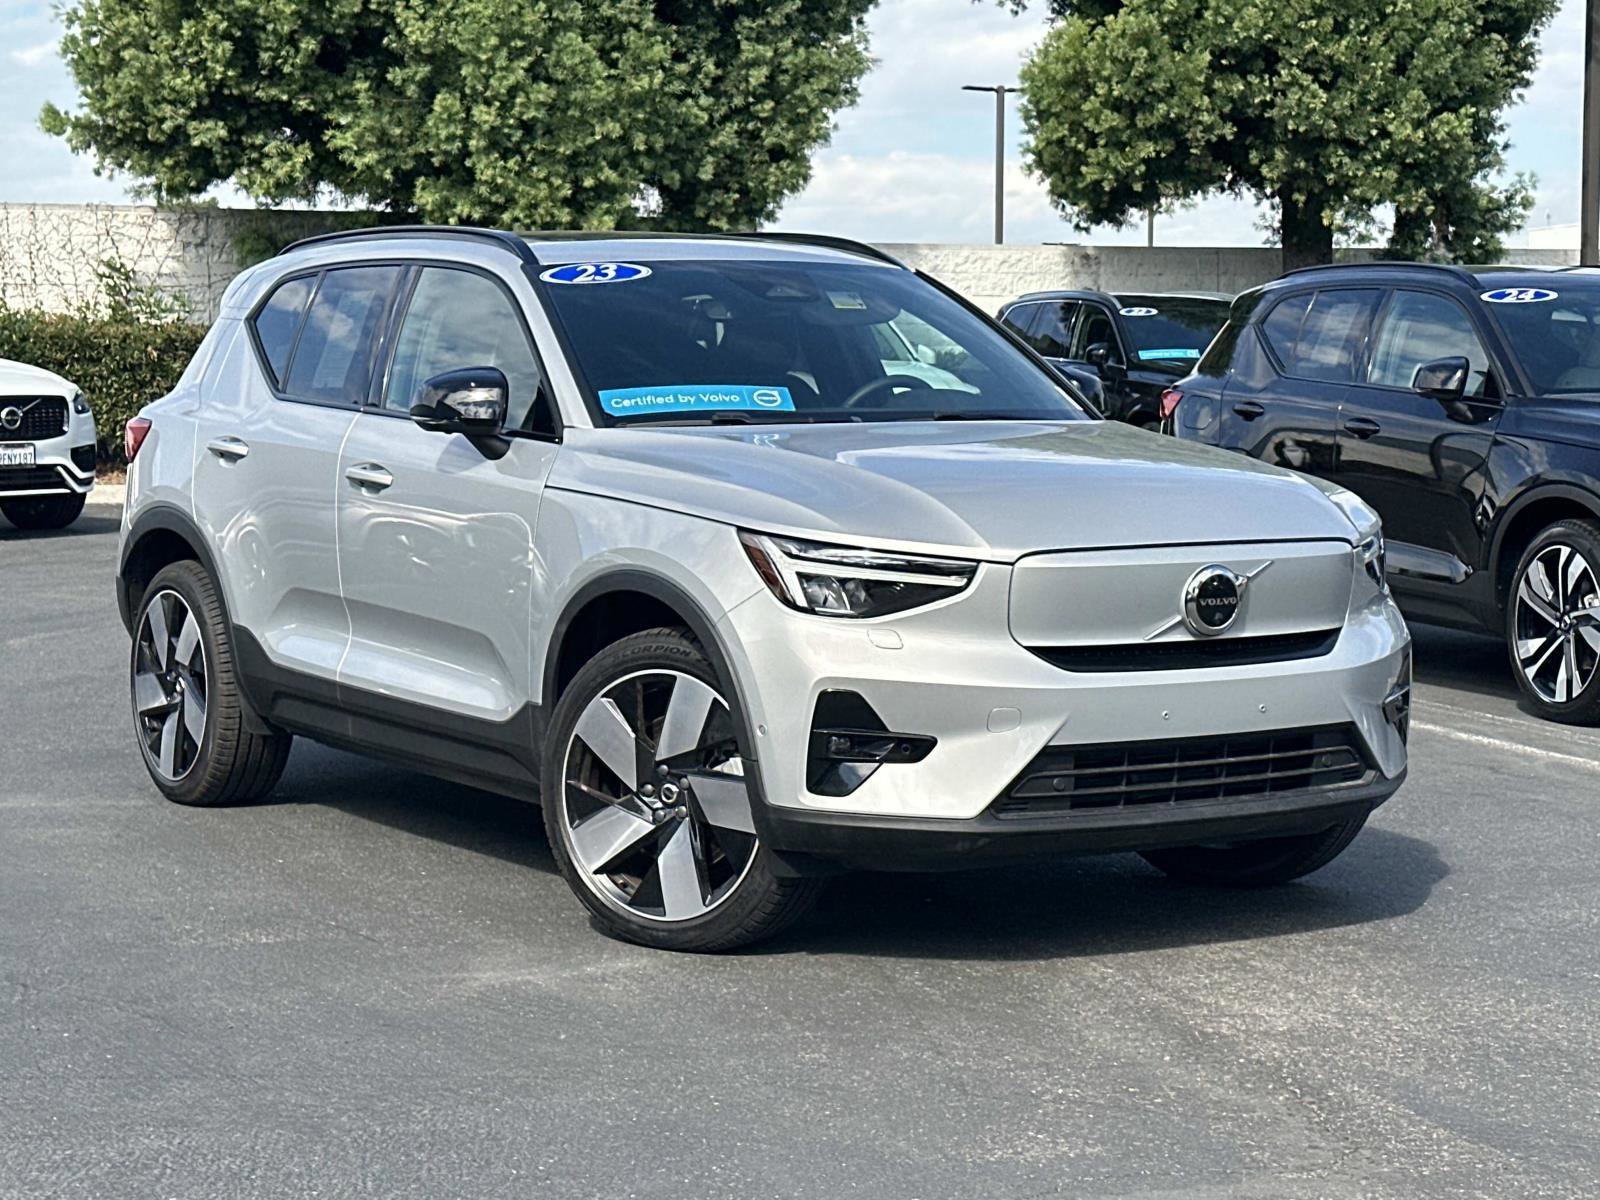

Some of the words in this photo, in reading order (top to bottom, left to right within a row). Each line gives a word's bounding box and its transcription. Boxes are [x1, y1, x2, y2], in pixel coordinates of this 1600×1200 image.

[572, 263, 618, 282] 23
[1501, 288, 1536, 301] 24
[611, 395, 674, 408] Certified
[678, 394, 696, 404] by
[699, 393, 740, 402] Volvo
[1199, 597, 1237, 606] VOLVO
[612, 645, 692, 661] CORPION
